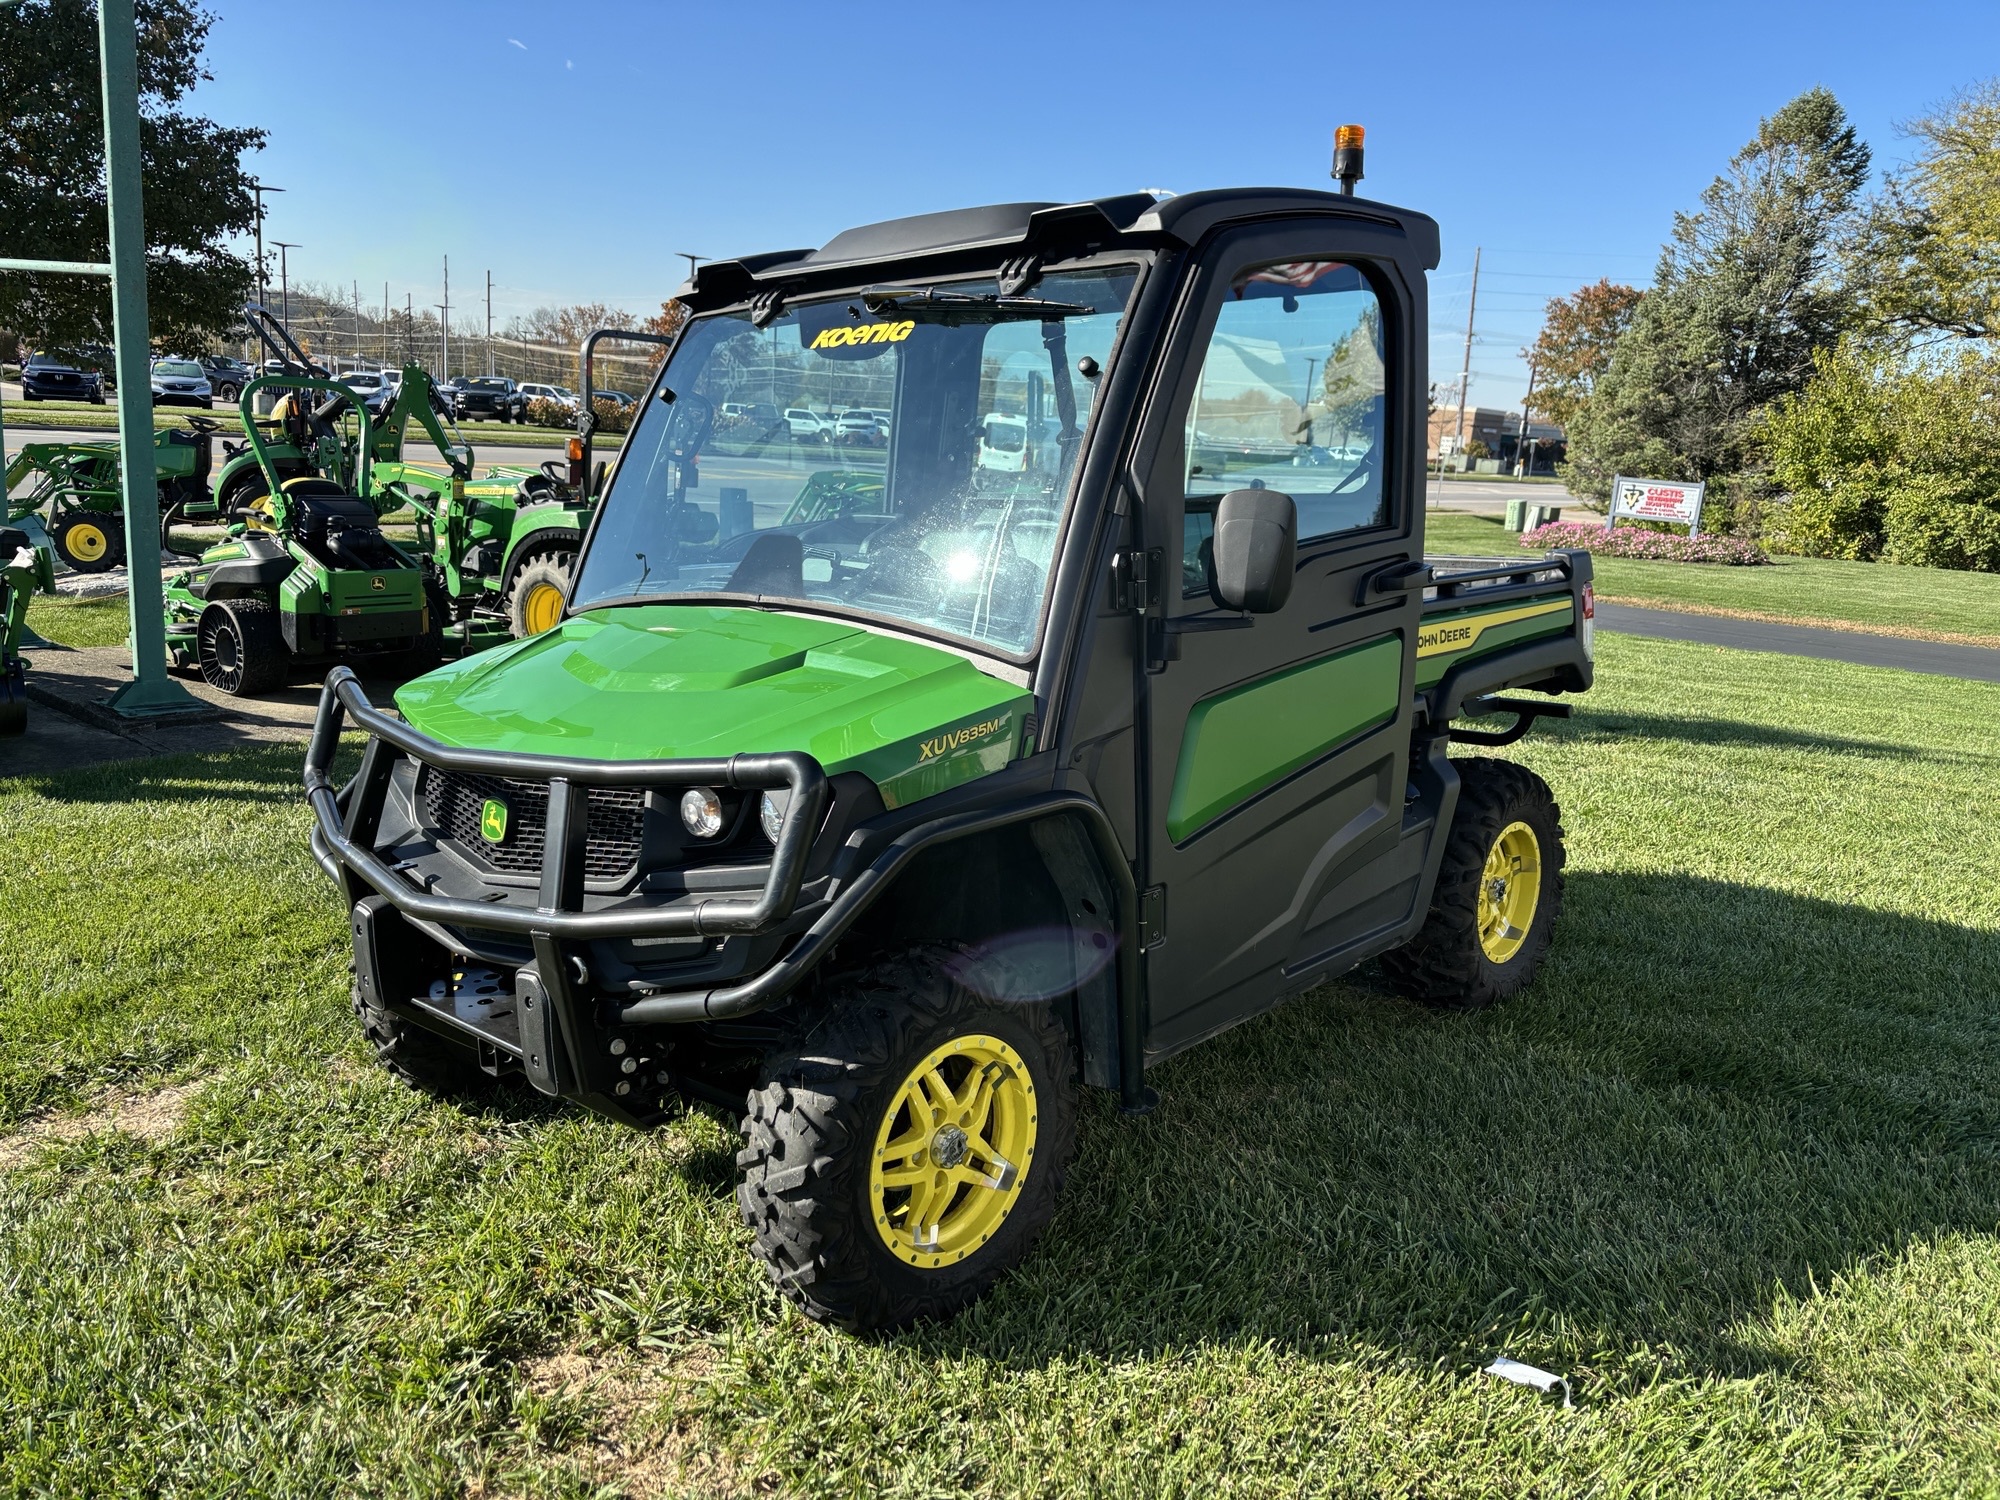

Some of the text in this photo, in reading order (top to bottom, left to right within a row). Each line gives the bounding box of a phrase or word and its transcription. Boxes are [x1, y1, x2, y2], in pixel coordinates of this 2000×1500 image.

[1417, 627, 1471, 649] OHN DEERE
[918, 718, 1000, 763] XUV835M
